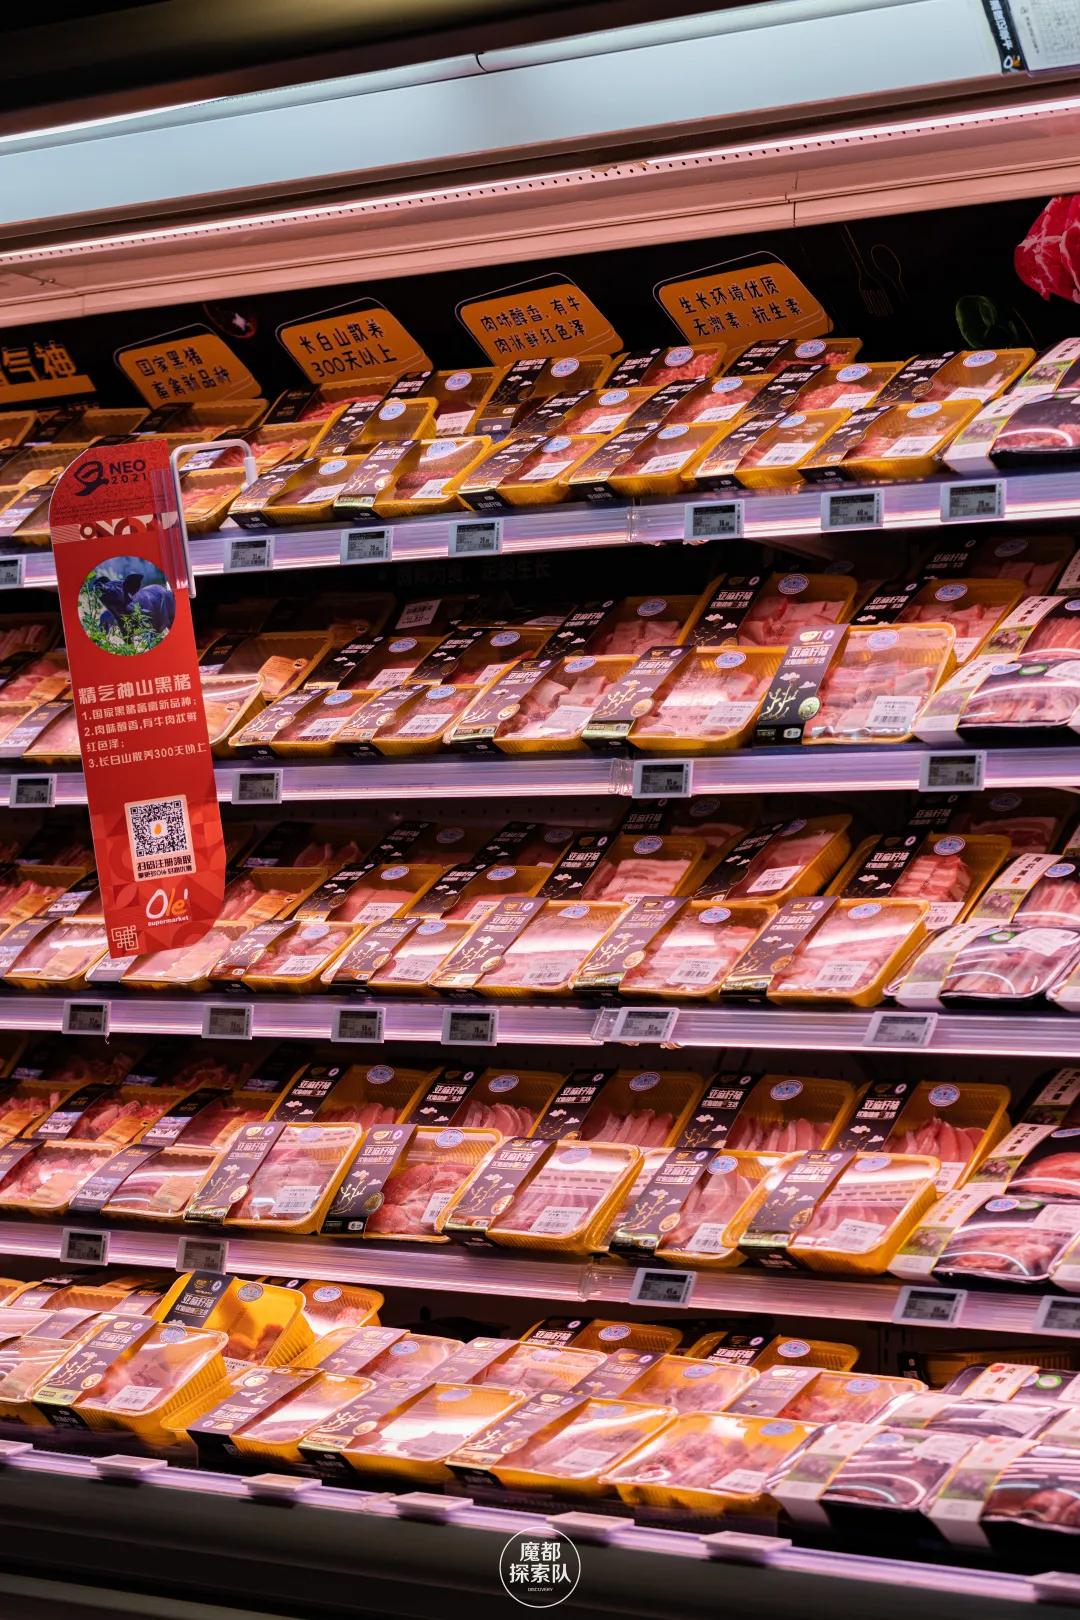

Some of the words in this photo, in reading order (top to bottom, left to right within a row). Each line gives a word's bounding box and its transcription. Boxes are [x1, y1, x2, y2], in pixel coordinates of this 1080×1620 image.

[679, 275, 781, 314] 生长环境优质
[299, 318, 384, 354] 长白山散养
[494, 319, 586, 353] 肉状鲜红色泽
[0, 341, 77, 386] 气神
[136, 346, 203, 377] 国家黑猪
[311, 344, 397, 378] 300天以上
[152, 365, 231, 400] 畜禽新品种
[110, 459, 146, 475] NEO
[111, 473, 147, 485] 2021
[78, 673, 192, 705] 精气神山黑猪
[88, 743, 207, 769] 3.长白山散养300天以上
[137, 855, 192, 872] 扫码注册领取
[147, 915, 189, 927] supermarket
